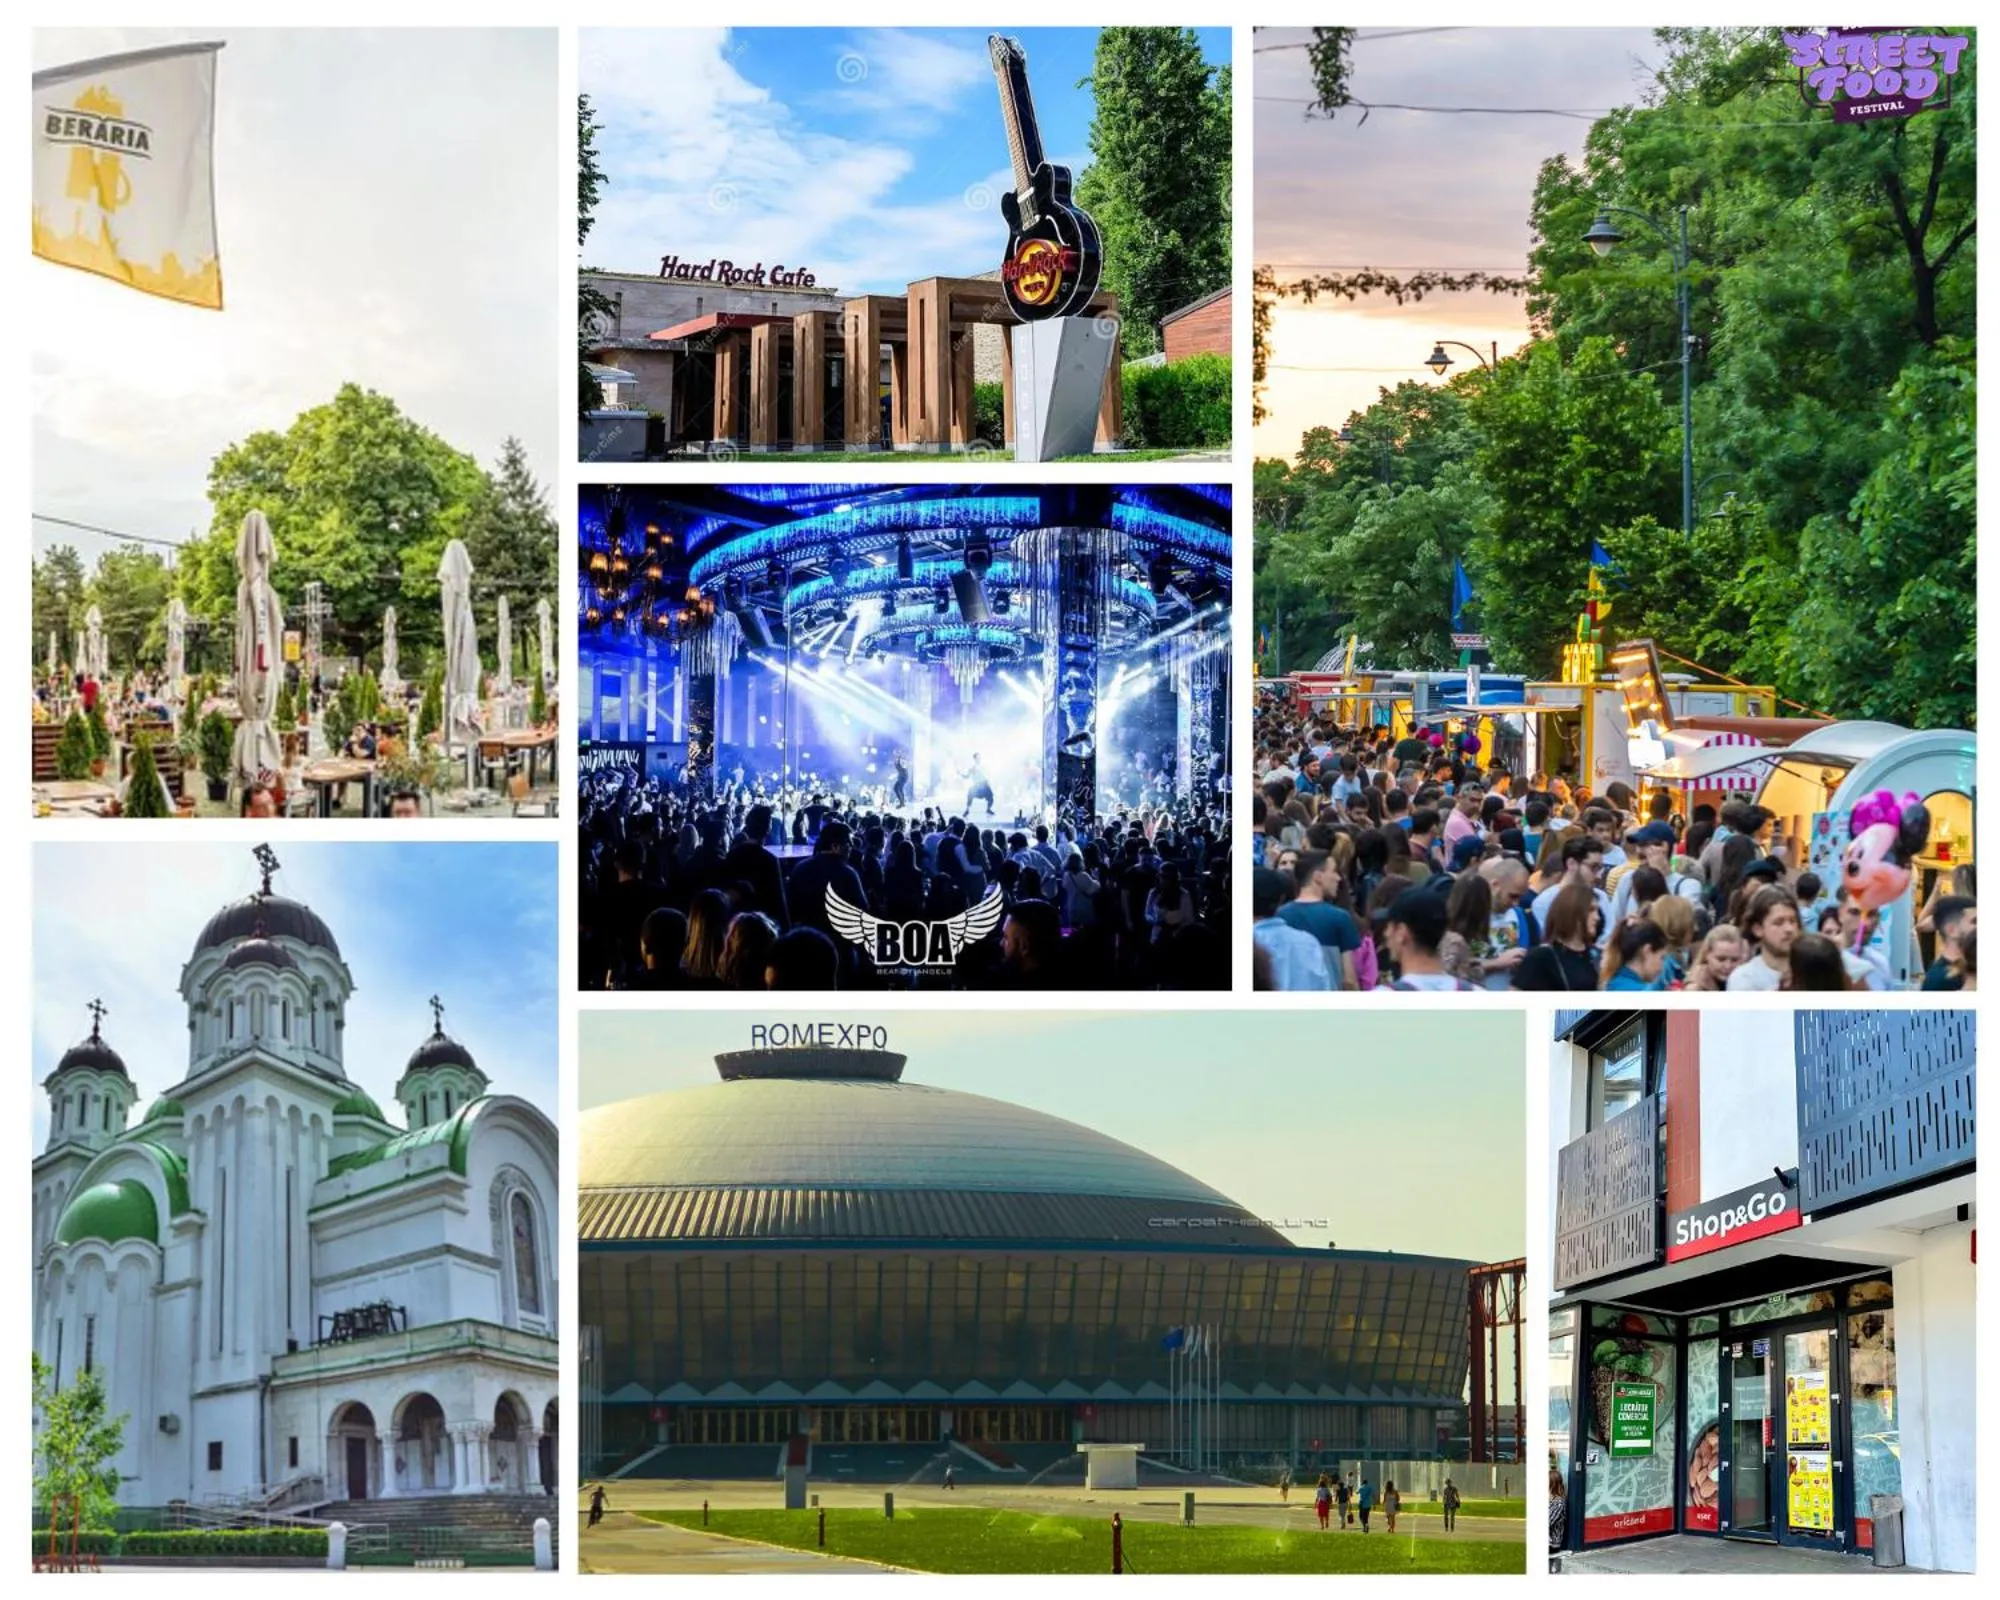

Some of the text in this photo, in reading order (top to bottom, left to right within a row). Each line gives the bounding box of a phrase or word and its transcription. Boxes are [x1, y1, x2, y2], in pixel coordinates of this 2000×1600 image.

[659, 255, 817, 288] Hard Rock Cafe
[751, 1022, 888, 1050] ROMEXPO
[1675, 1192, 1787, 1246] Shop&Go
